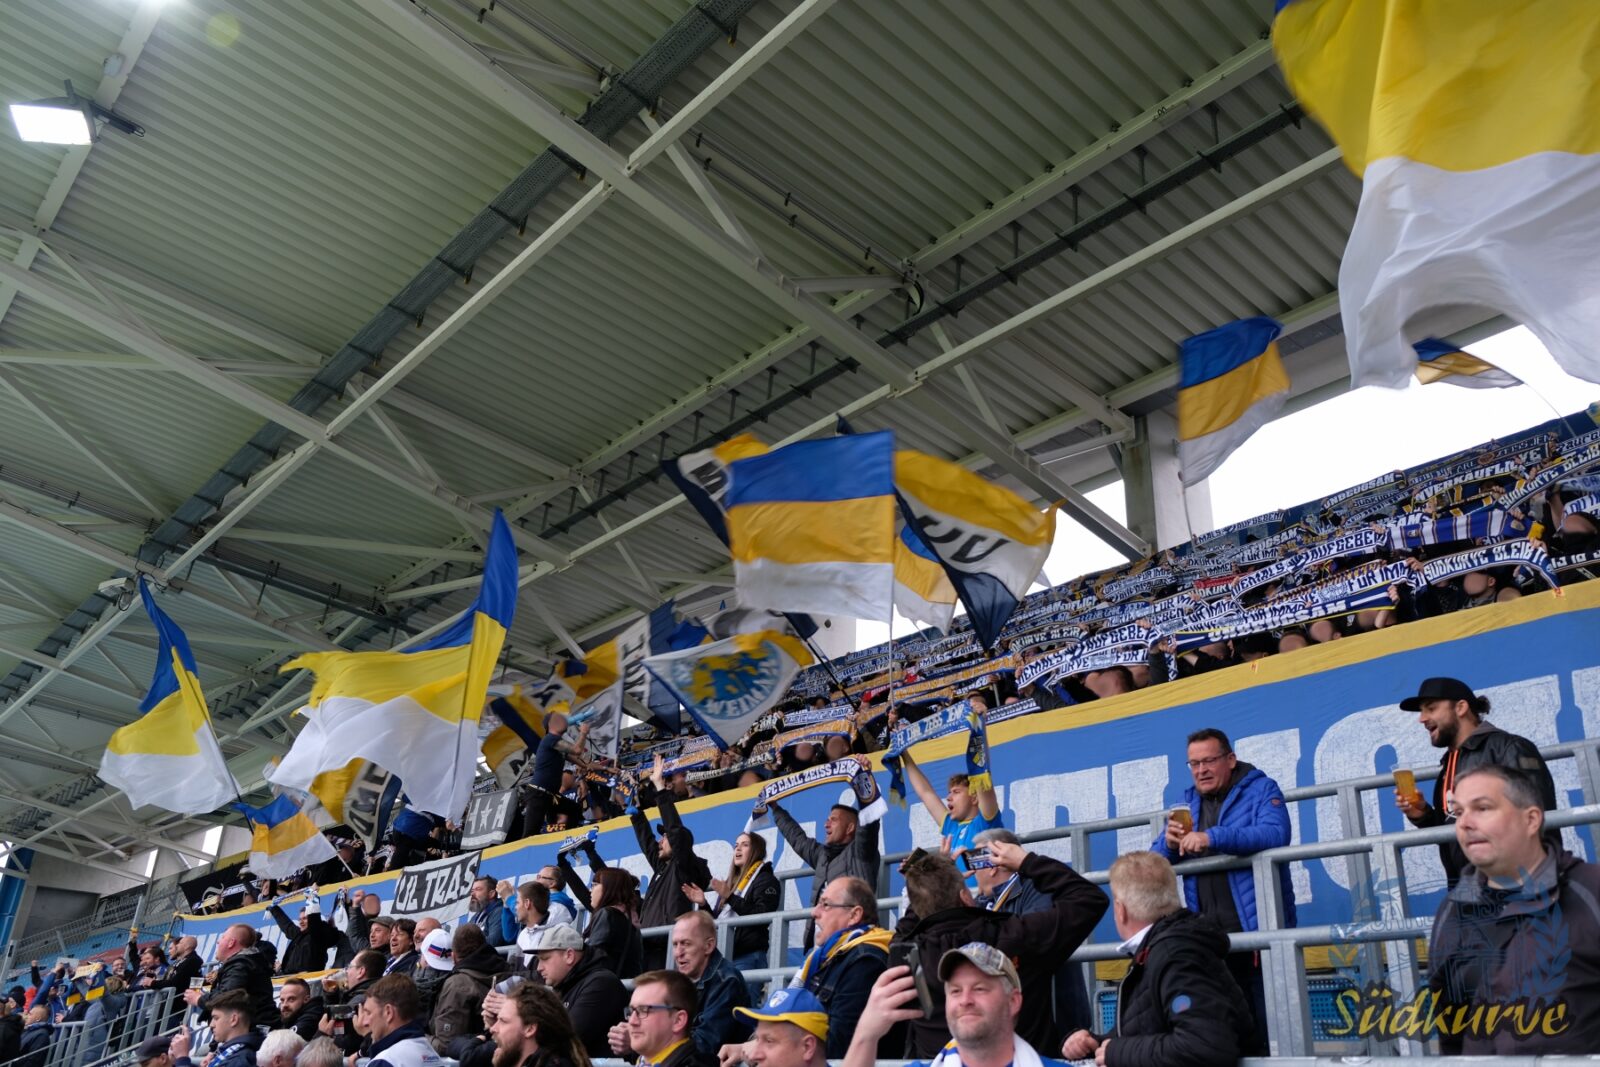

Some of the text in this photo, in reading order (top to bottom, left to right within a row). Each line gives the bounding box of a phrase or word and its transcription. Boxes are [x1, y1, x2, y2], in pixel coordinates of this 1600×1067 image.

[1492, 541, 1548, 566] BLEIBT!
[765, 758, 861, 799] FC CARL ZEISS JENA
[395, 853, 479, 912] ULTRAS
